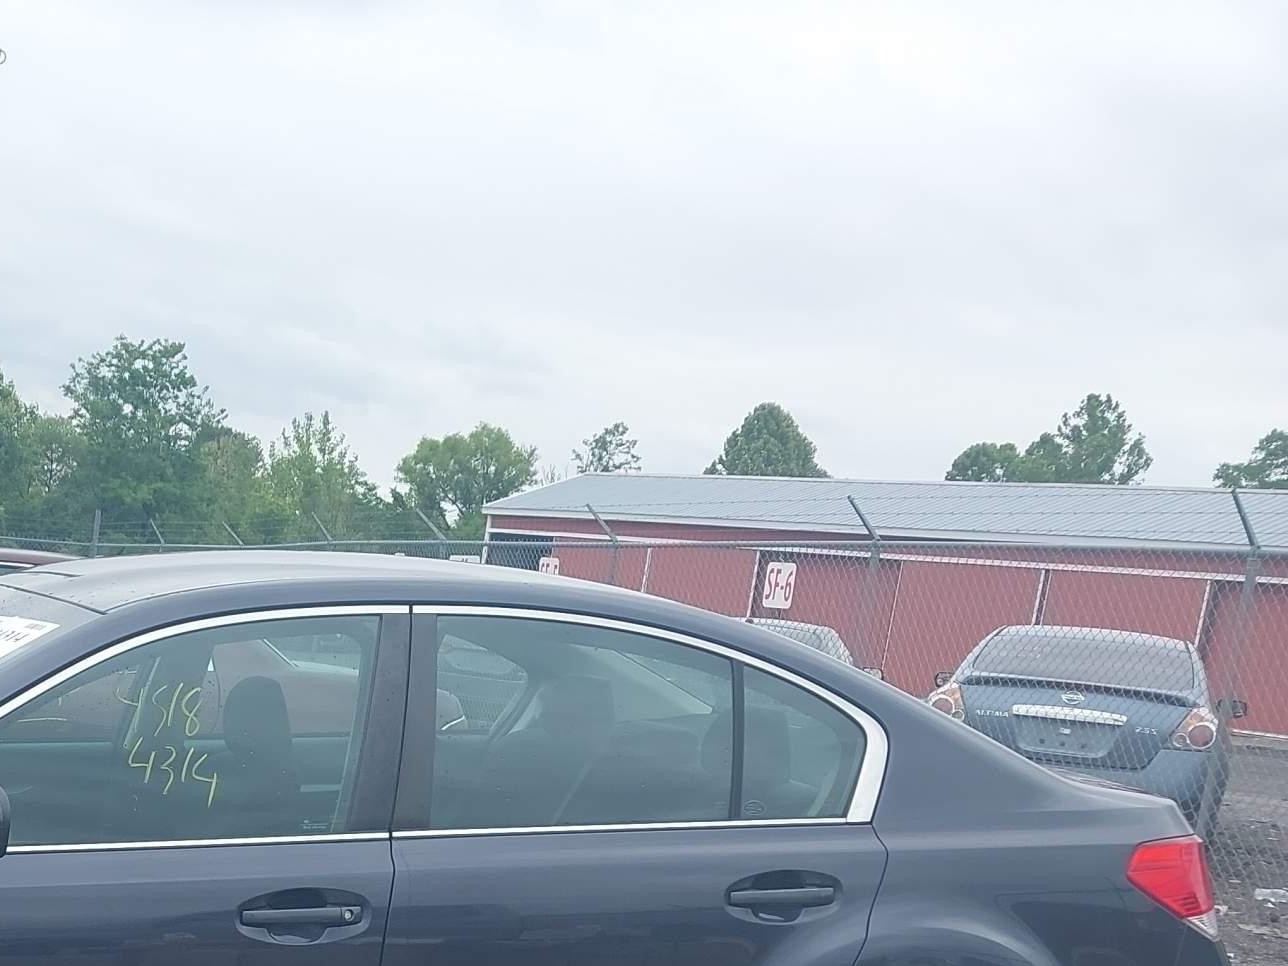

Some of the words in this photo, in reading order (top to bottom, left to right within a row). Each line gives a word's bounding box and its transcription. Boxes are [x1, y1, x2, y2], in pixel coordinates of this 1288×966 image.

[765, 567, 794, 602] SF-6
[115, 682, 202, 737] 4518
[127, 736, 218, 808] 4314
